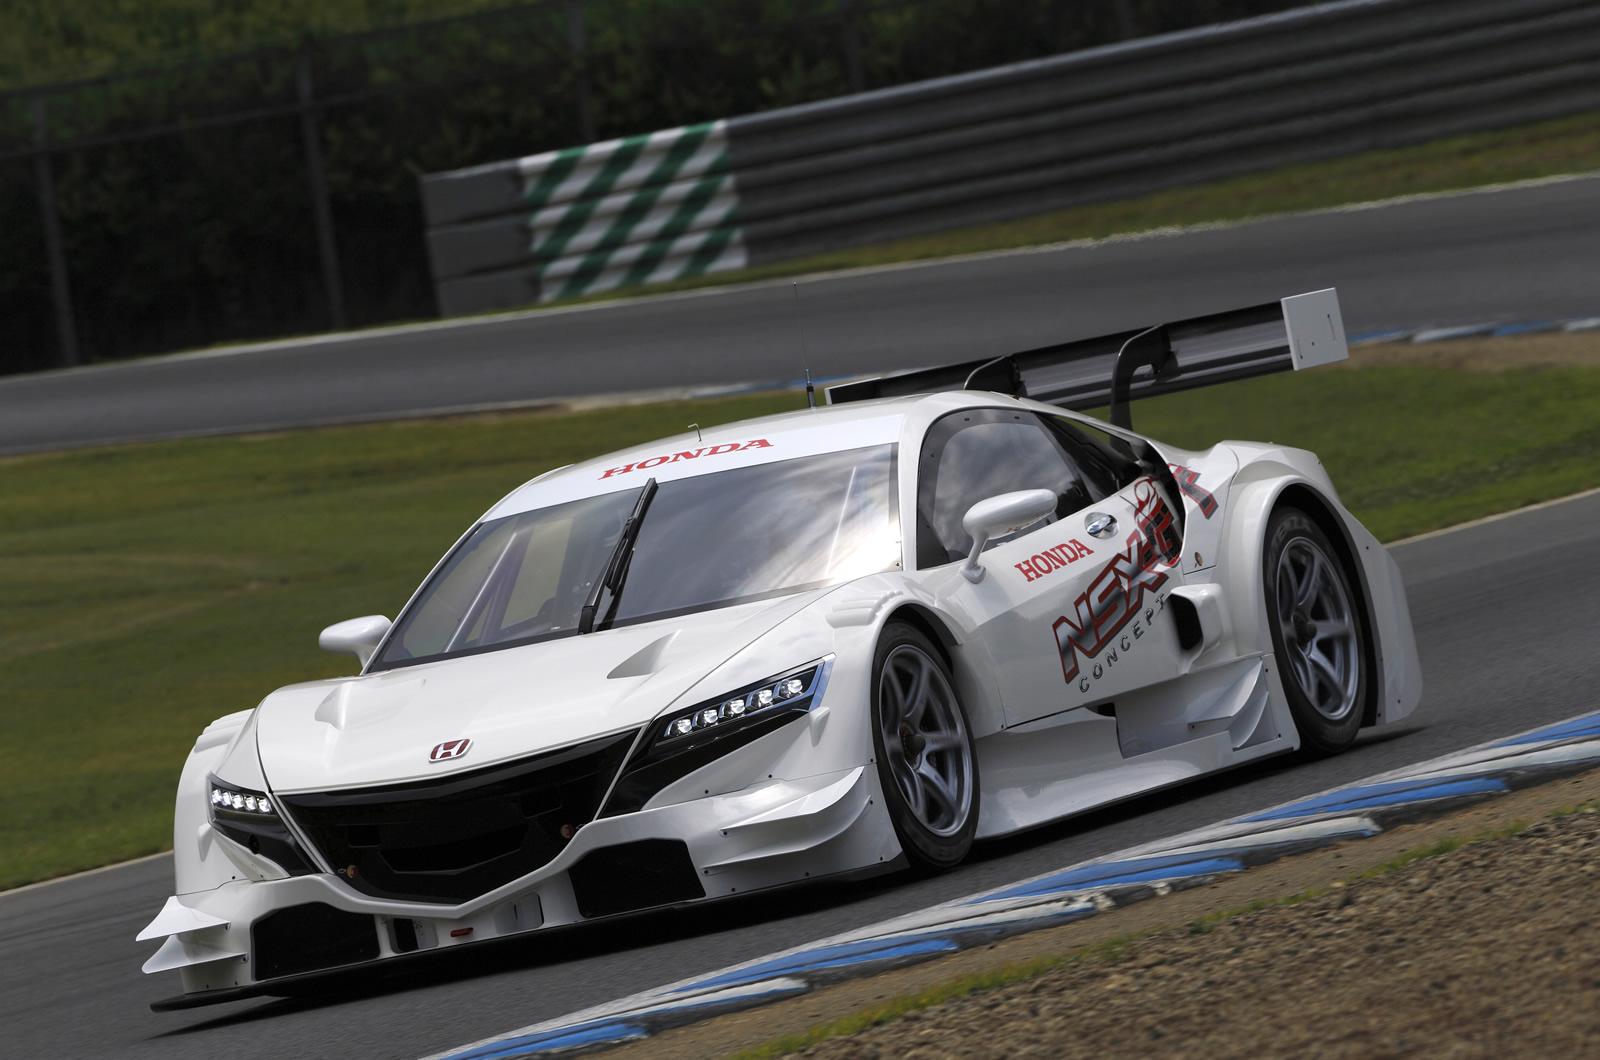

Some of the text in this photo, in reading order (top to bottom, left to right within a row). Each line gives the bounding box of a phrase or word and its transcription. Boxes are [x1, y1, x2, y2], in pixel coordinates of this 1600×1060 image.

[598, 438, 774, 480] HONDA
[1014, 538, 1095, 582] HONDA
[1079, 593, 1166, 693] CONCEPT
